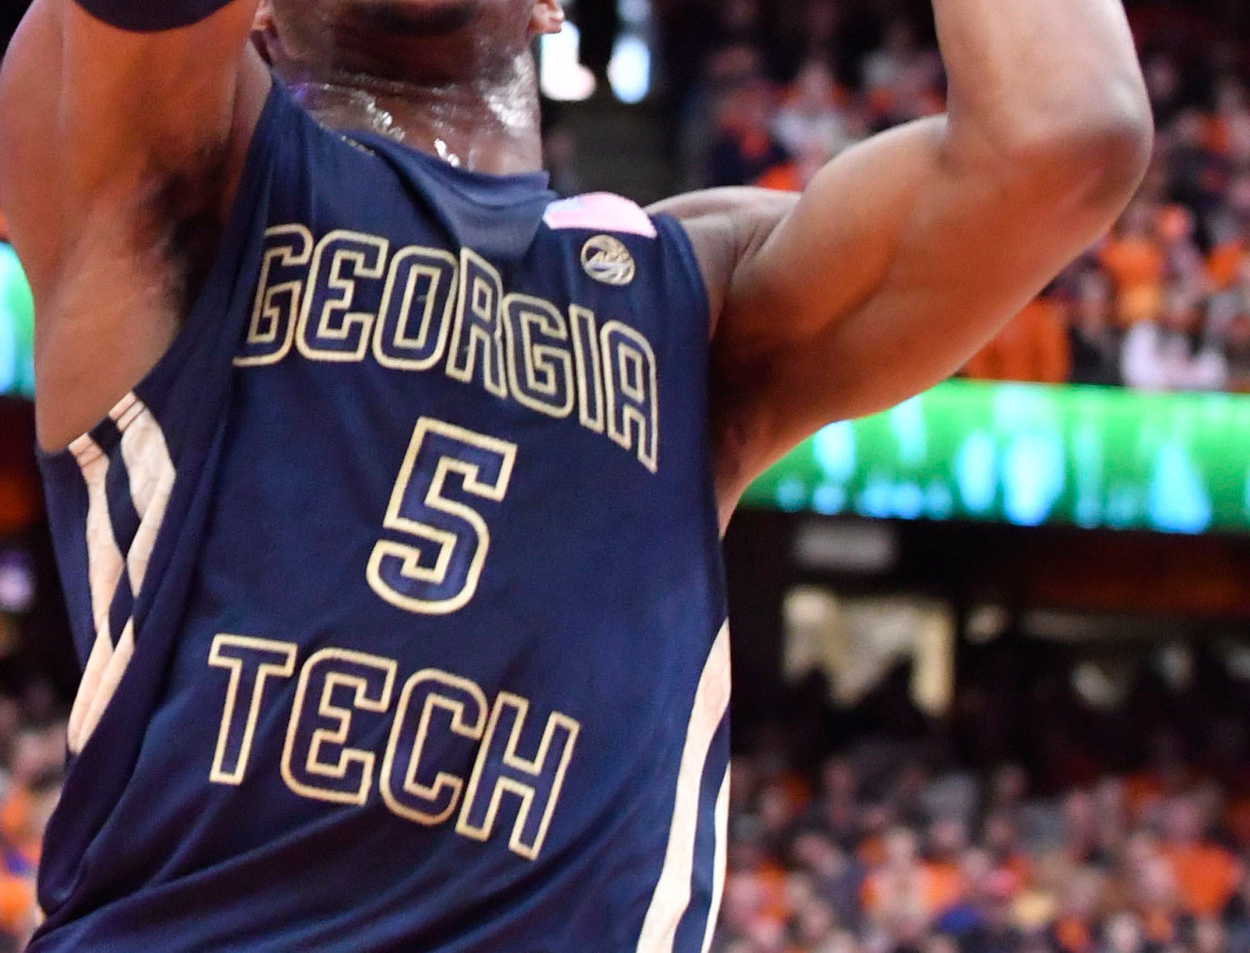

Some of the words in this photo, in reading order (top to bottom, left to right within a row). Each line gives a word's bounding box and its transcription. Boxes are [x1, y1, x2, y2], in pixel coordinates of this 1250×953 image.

[233, 223, 658, 474] GEORGIA
[365, 415, 517, 614] 5
[208, 632, 580, 860] TECH
